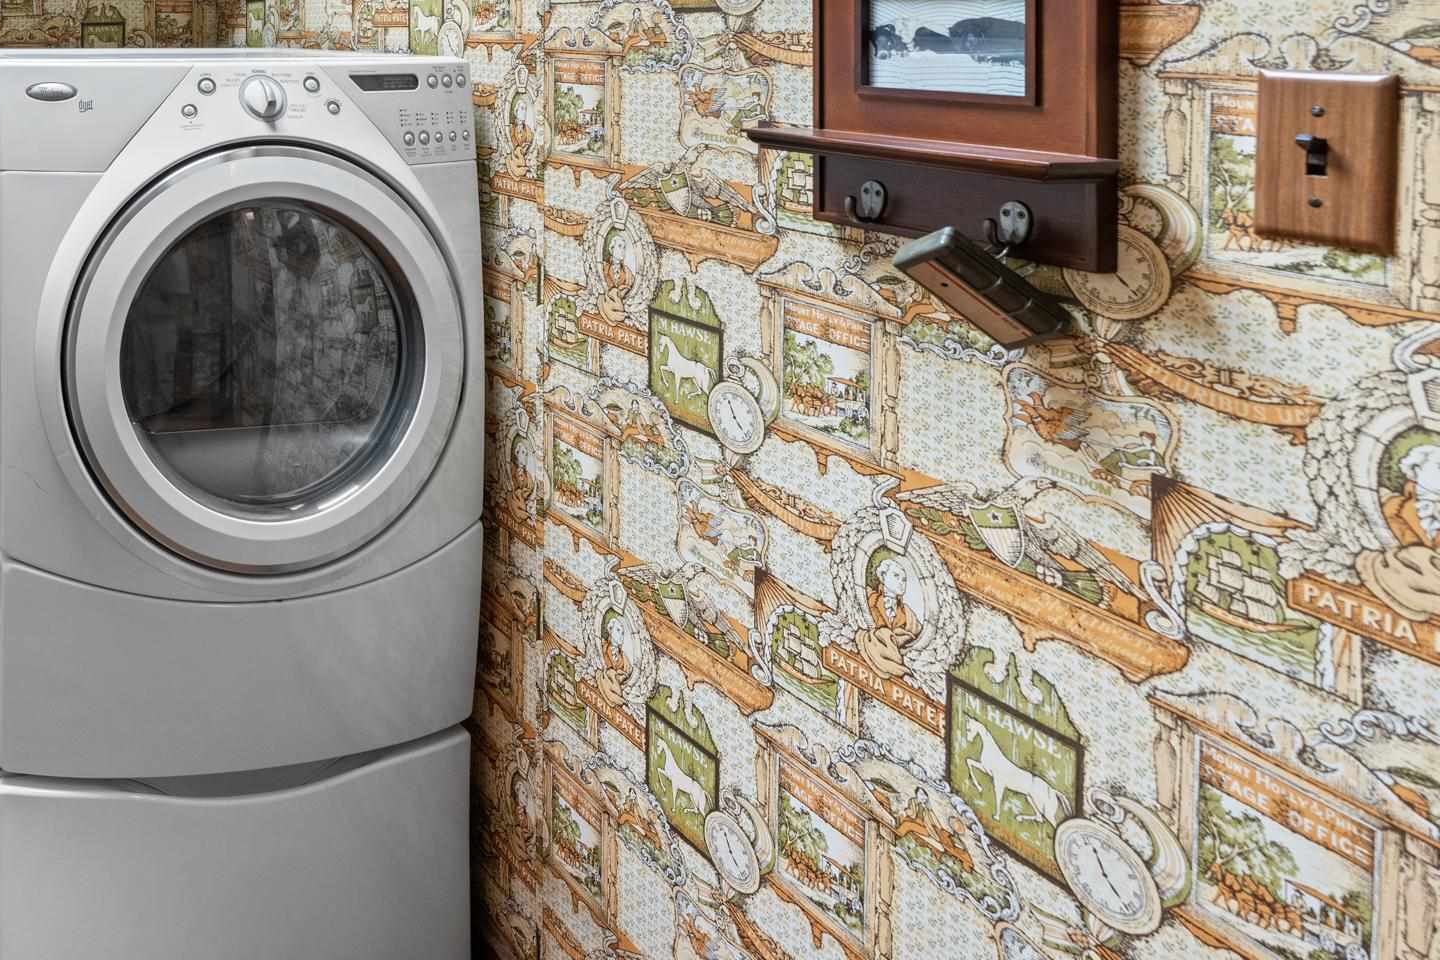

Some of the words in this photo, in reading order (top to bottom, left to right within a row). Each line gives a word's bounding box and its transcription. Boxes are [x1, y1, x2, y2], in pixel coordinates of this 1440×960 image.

[582, 319, 614, 338] PATRIA
[1303, 583, 1417, 644] PATRIA
[831, 650, 886, 696] PATRIA
[987, 705, 1061, 759] HAWSE
[1288, 811, 1372, 866] OFFICE
